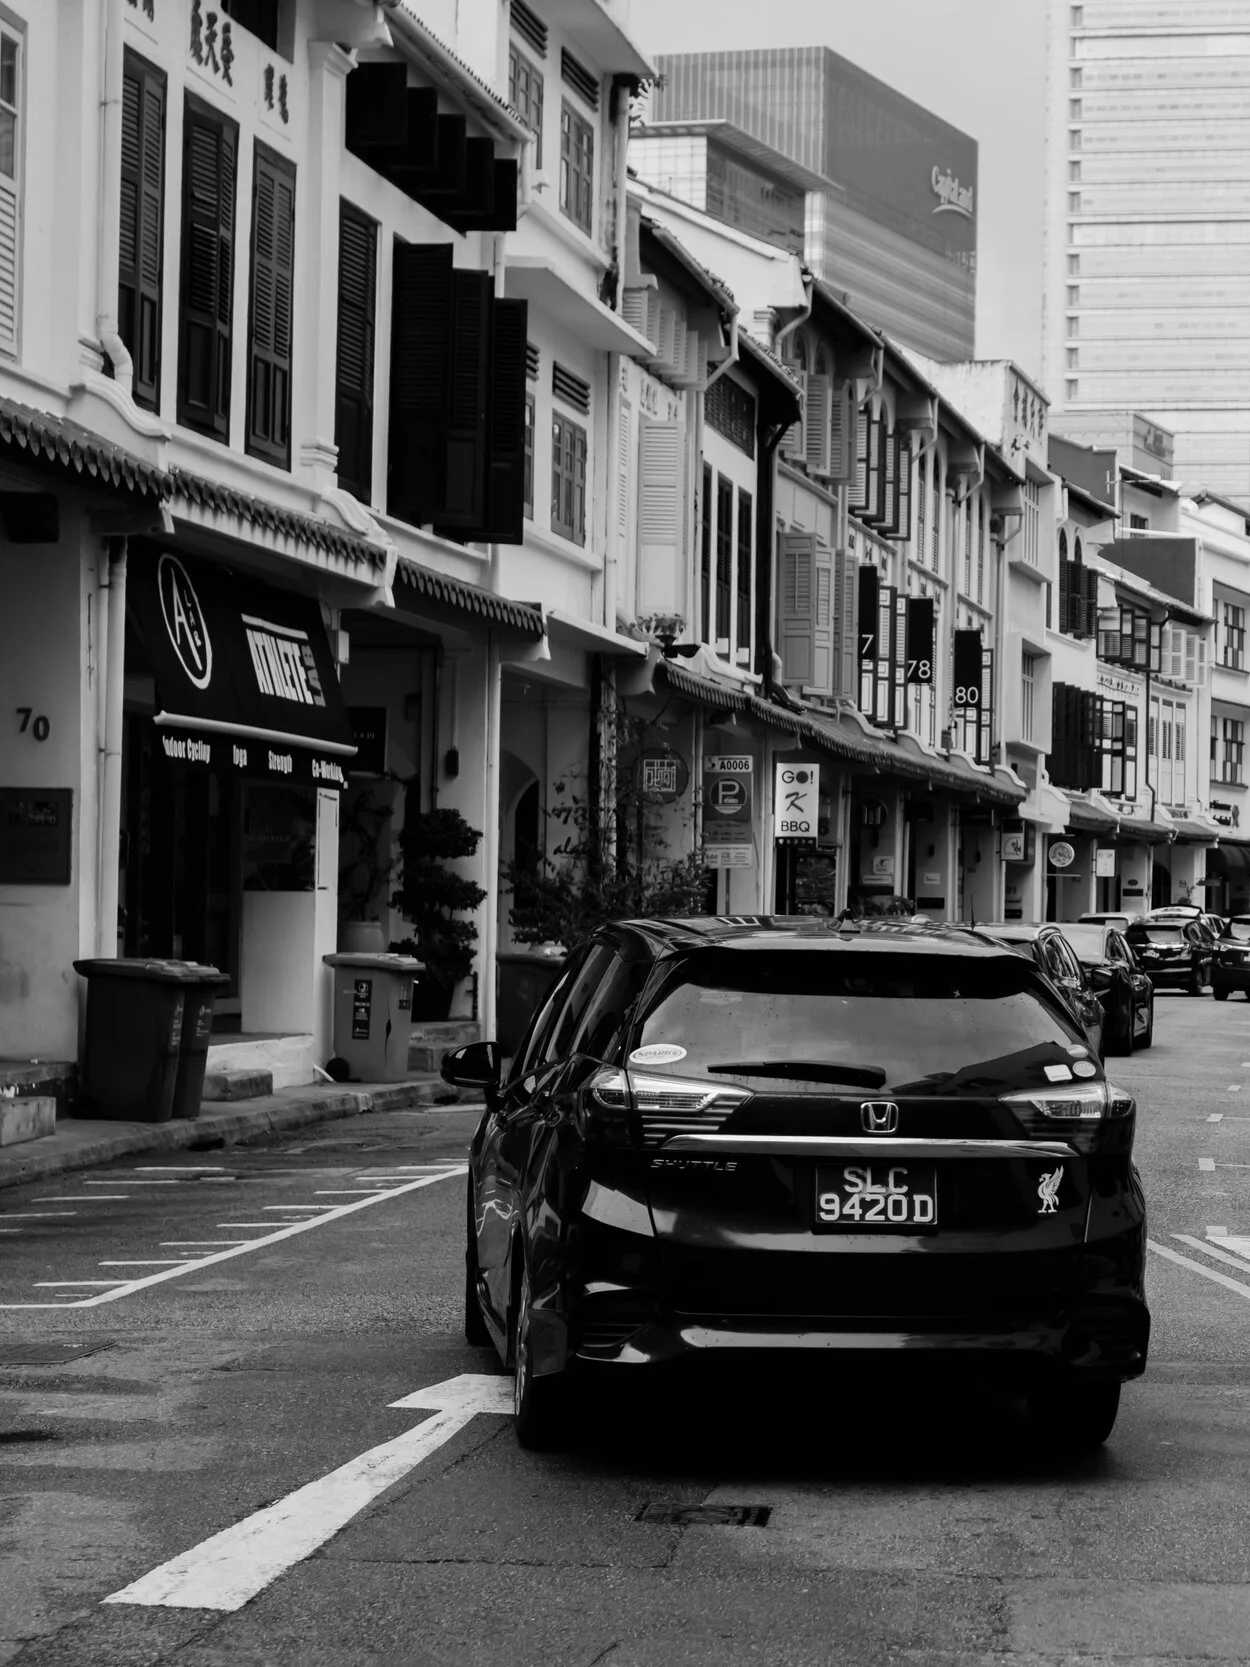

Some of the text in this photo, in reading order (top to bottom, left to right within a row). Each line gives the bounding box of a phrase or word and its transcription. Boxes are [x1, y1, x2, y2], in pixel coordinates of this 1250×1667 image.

[907, 660, 931, 679] 78
[955, 686, 979, 704] 80
[16, 707, 50, 742] 70
[187, 738, 211, 764] Cycling
[268, 750, 293, 774] Strength
[719, 760, 750, 770] A0006
[781, 770, 814, 784] GO!
[780, 821, 810, 832] BBQ
[650, 1159, 737, 1172] SHUTTLE
[843, 1167, 908, 1194] SLC
[819, 1193, 933, 1222] 9420D
